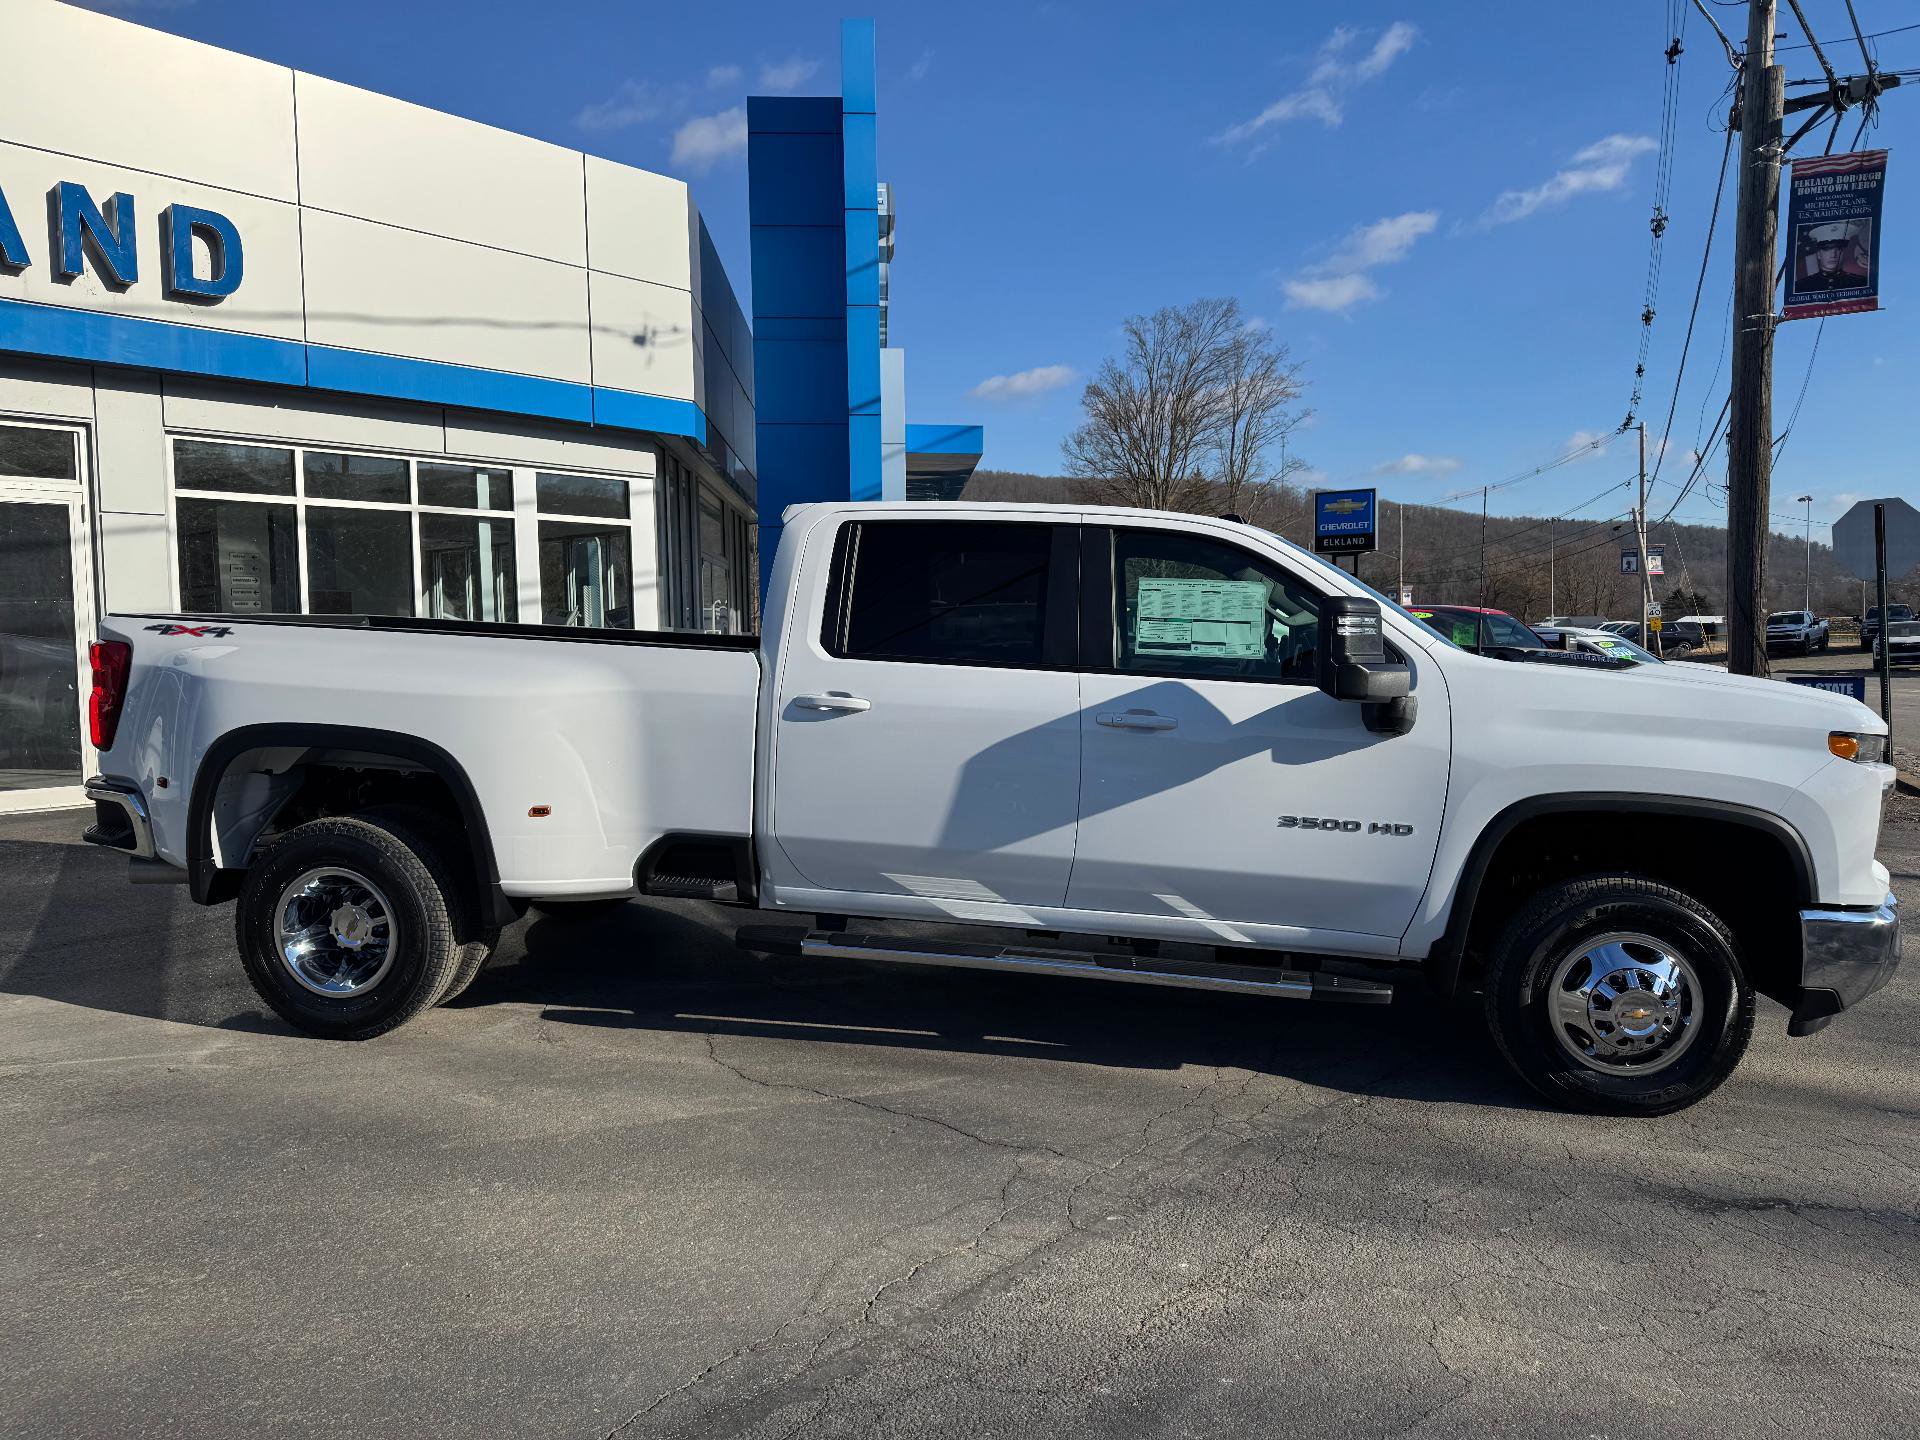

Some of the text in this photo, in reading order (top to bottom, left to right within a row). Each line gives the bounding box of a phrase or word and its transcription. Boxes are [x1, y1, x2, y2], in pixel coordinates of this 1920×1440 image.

[1794, 177, 1833, 188] ELKLAND
[1797, 184, 1848, 195] HOMETOWN
[1804, 200, 1840, 209] MICHAEL
[1320, 521, 1370, 531] CHEVROLET
[1323, 537, 1365, 546] ELKLAND
[1276, 815, 1414, 837] 3500 HD
